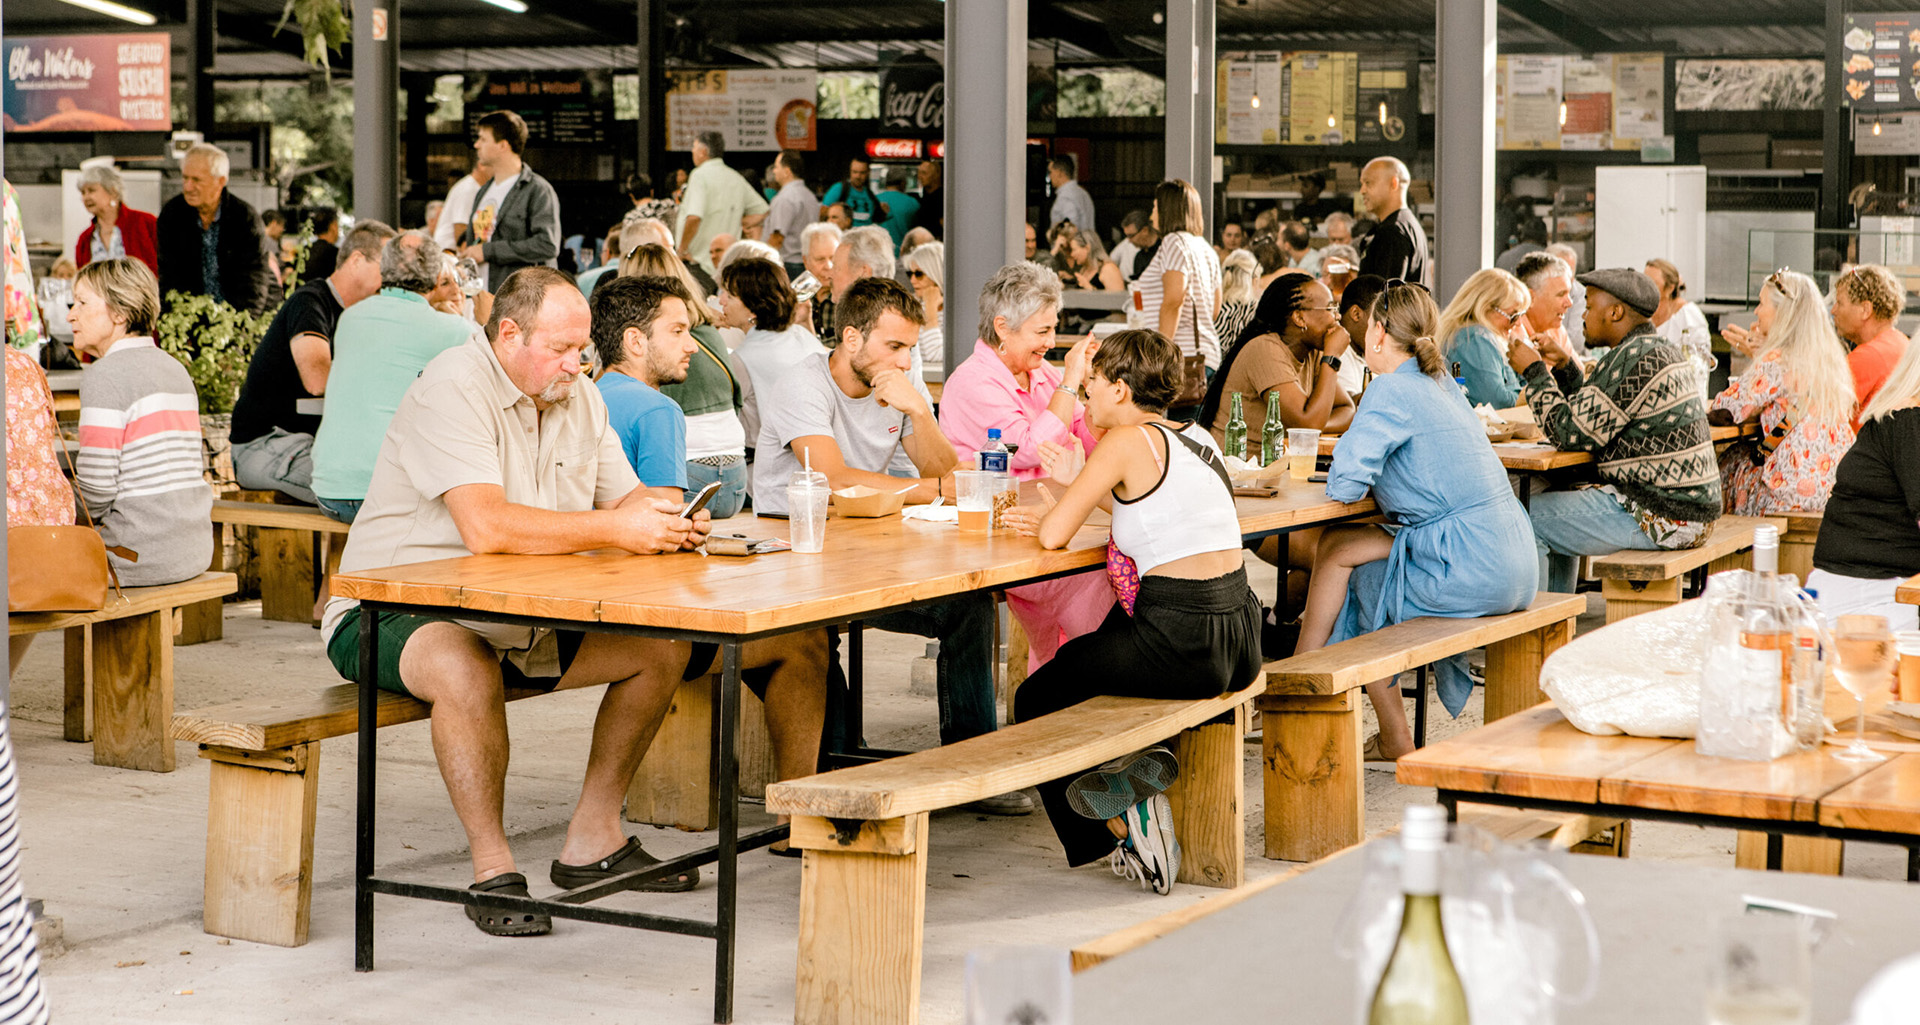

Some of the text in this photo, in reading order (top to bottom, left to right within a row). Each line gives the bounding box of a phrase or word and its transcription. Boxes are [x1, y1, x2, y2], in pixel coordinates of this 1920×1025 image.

[8, 45, 96, 80] Blue Waters
[117, 43, 164, 65] SEAFOOD
[118, 67, 165, 97] SUSHI
[671, 73, 723, 91] RIBS
[119, 99, 165, 120] OYSTERS
[875, 140, 914, 157] Coca-Cola
